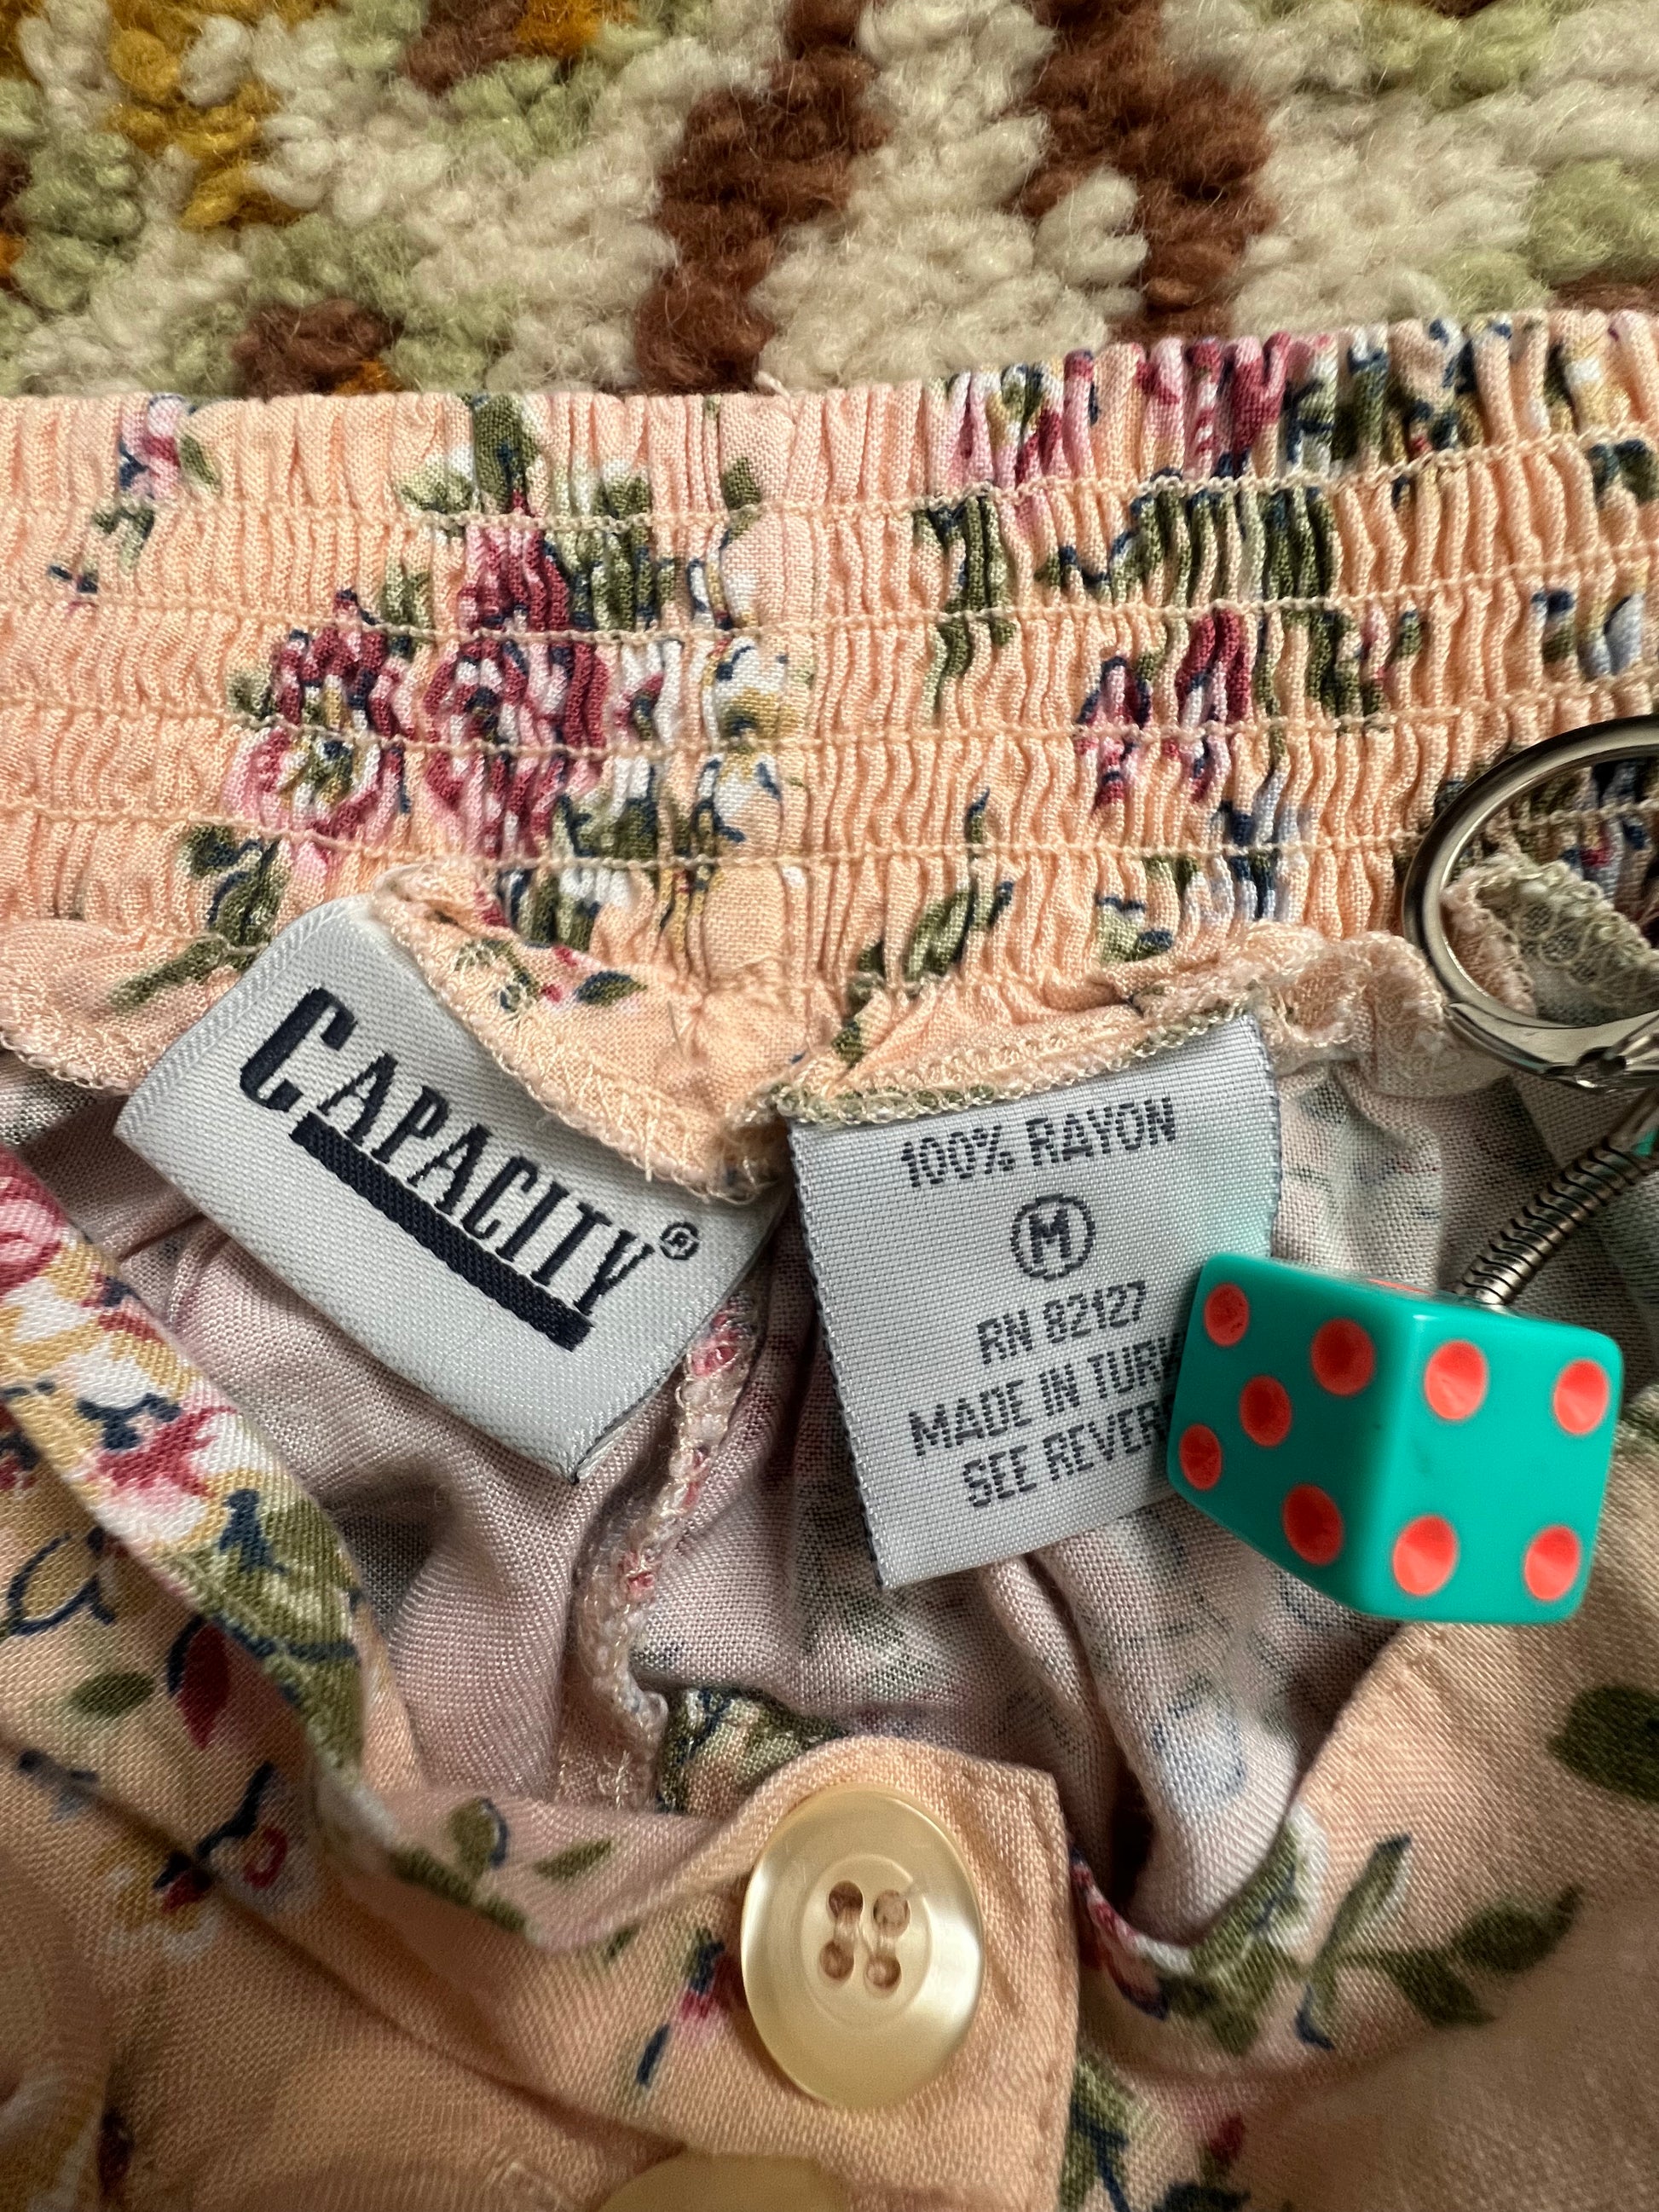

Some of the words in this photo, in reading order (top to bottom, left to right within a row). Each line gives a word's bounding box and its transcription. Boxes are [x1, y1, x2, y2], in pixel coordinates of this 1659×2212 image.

[900, 1123, 1016, 1187] 100%
[1026, 1096, 1176, 1166] RAYON
[1029, 1208, 1071, 1265] M
[977, 1309, 1032, 1366] RN
[1043, 1280, 1146, 1344] 82127
[908, 1378, 1032, 1457] MADE
[1038, 1363, 1080, 1417] IN
[962, 1445, 1038, 1508] SEE
